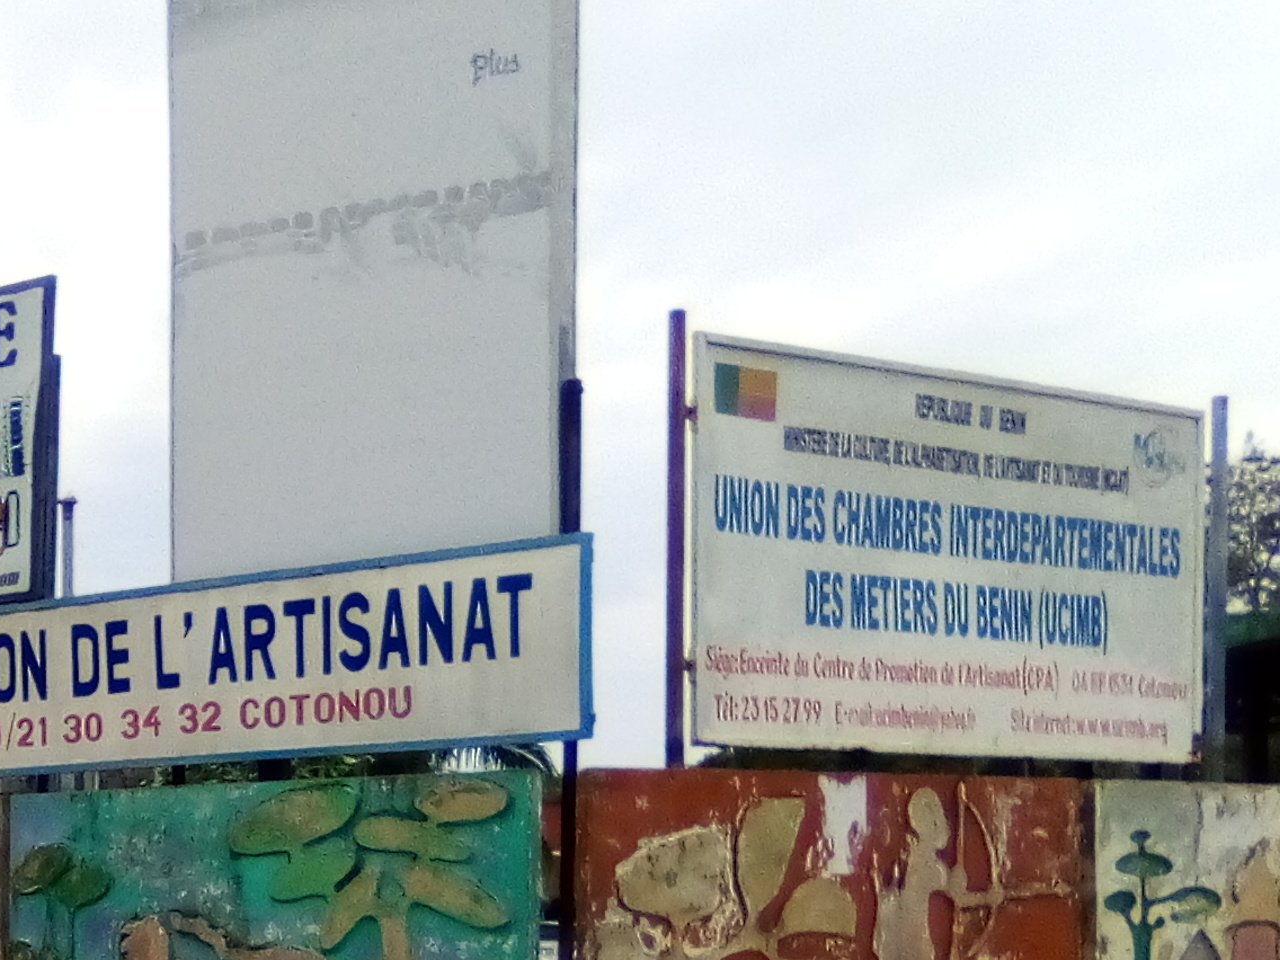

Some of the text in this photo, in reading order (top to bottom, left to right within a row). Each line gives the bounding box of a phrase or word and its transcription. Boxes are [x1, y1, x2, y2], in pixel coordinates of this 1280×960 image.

[714, 474, 1181, 578] UNION DES CHAMBRES INTERDEPARTEMENTALES
[71, 619, 131, 697] DE
[154, 572, 533, 690] L'ARTISANAT
[805, 569, 1108, 656] DES METIERS DU BENIN (UCIMB)
[794, 653, 809, 677] du
[813, 652, 854, 680] Centre
[859, 656, 871, 681] de
[874, 657, 937, 685] Promotion
[63, 711, 102, 743] 30
[120, 706, 162, 739] 34
[178, 701, 221, 734] 32
[239, 684, 413, 731] COTONOU
[742, 695, 760, 721] 23
[764, 695, 778, 723] 15
[782, 697, 800, 724] 27
[804, 697, 821, 724] 99
